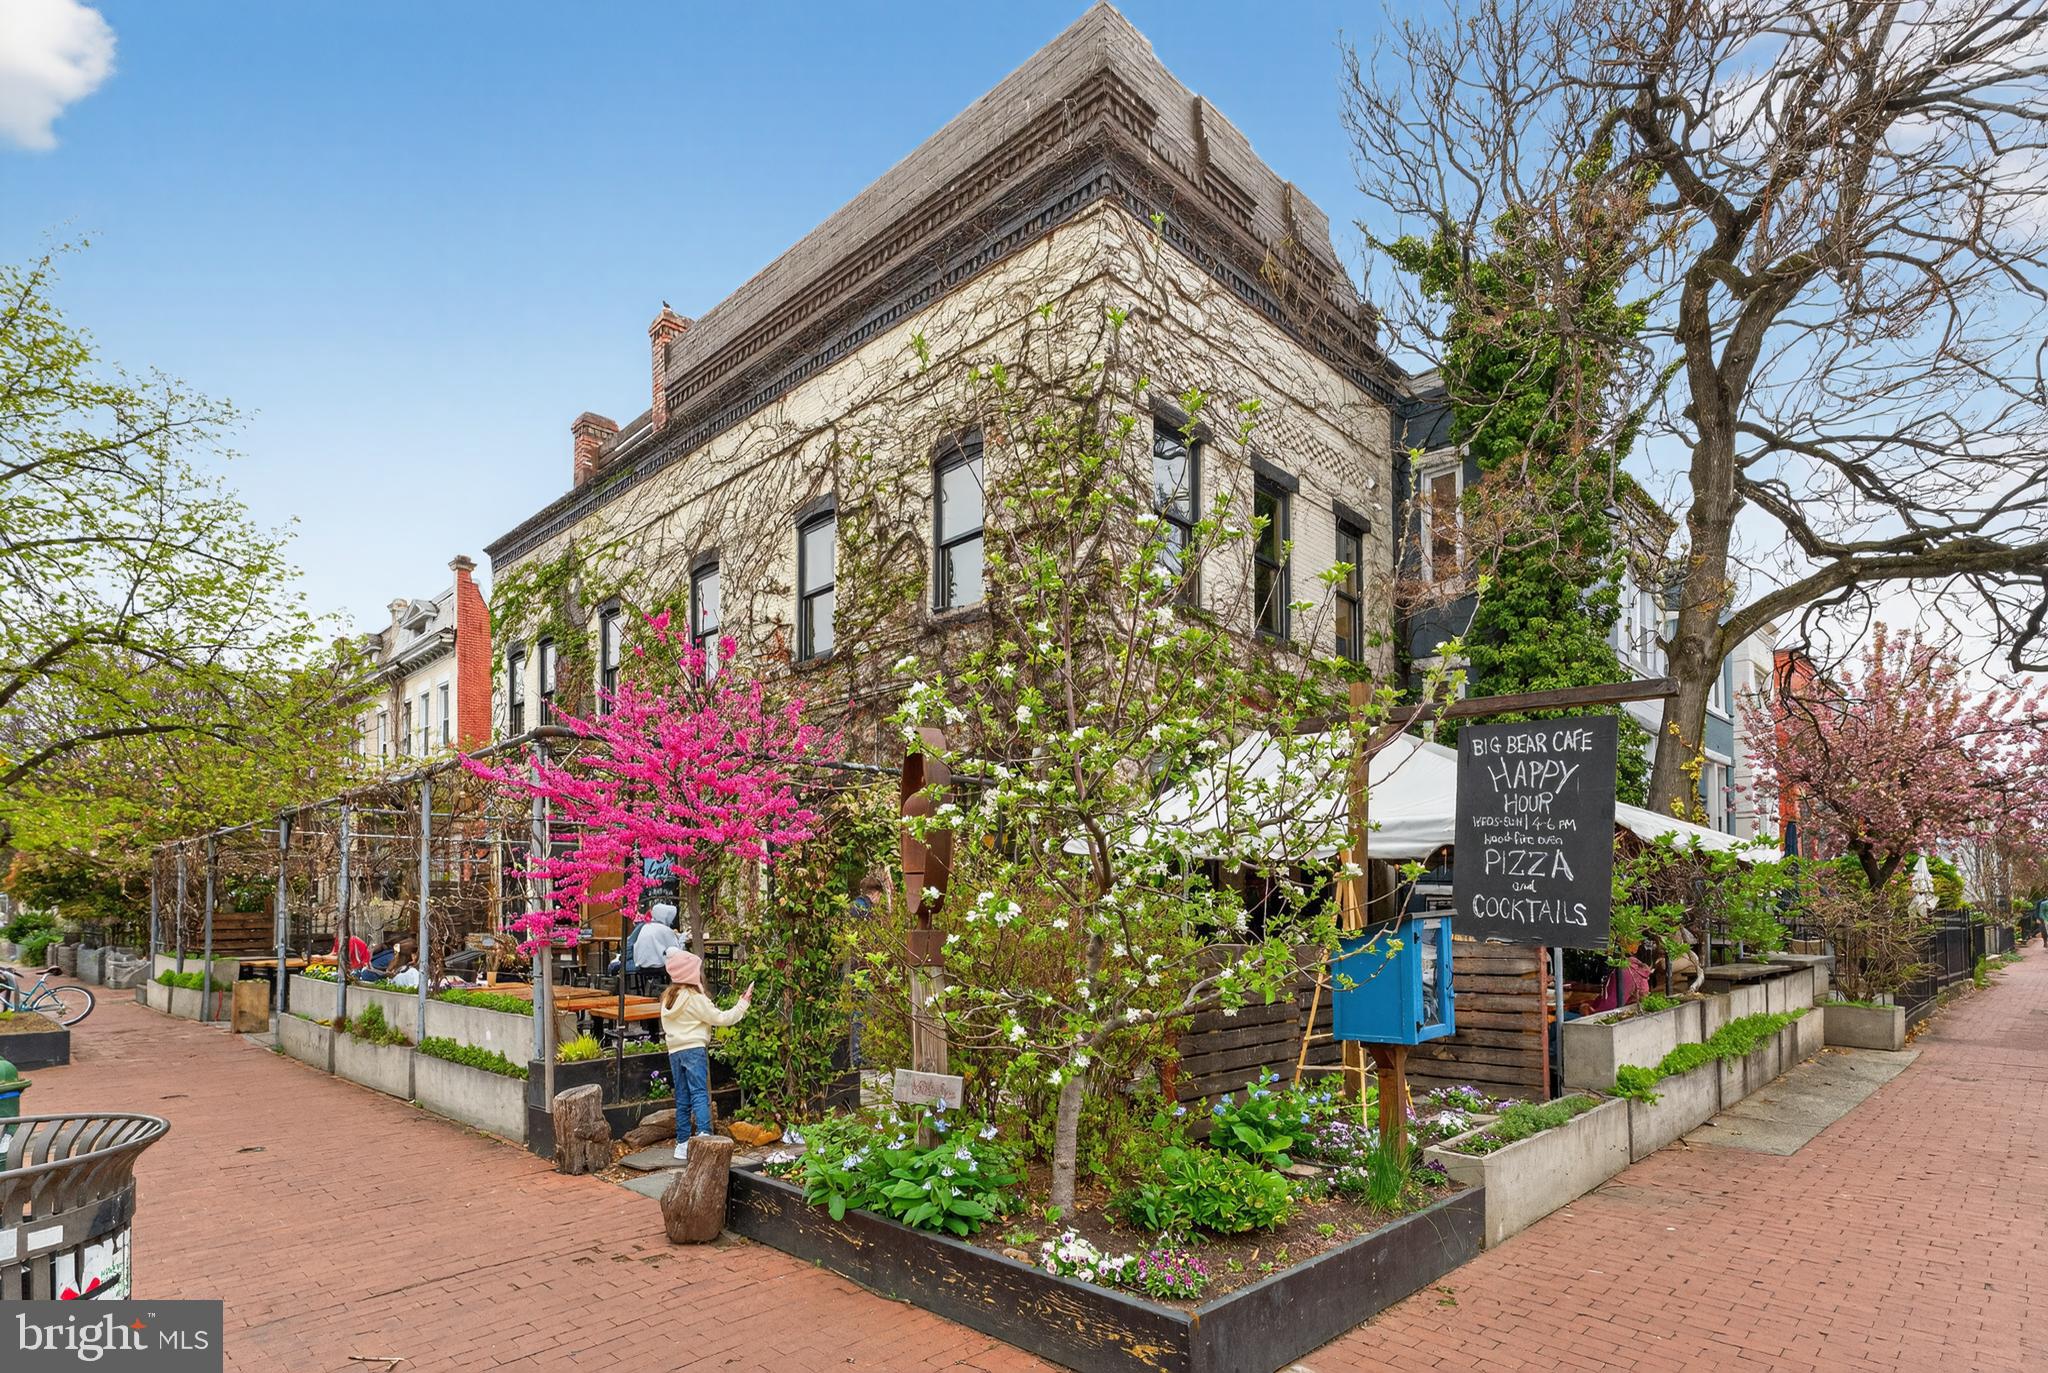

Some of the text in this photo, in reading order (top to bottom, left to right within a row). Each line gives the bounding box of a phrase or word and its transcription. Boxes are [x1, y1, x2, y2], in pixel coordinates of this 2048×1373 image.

[1472, 728, 1593, 756] BIG BEAR CAFE
[1487, 756, 1580, 794] HAPPY
[1503, 791, 1553, 816] HOUR
[1558, 818, 1577, 831] PM
[1485, 848, 1574, 882] PIZZA
[1512, 879, 1537, 893] and
[1472, 893, 1588, 926] COCKTAILS
